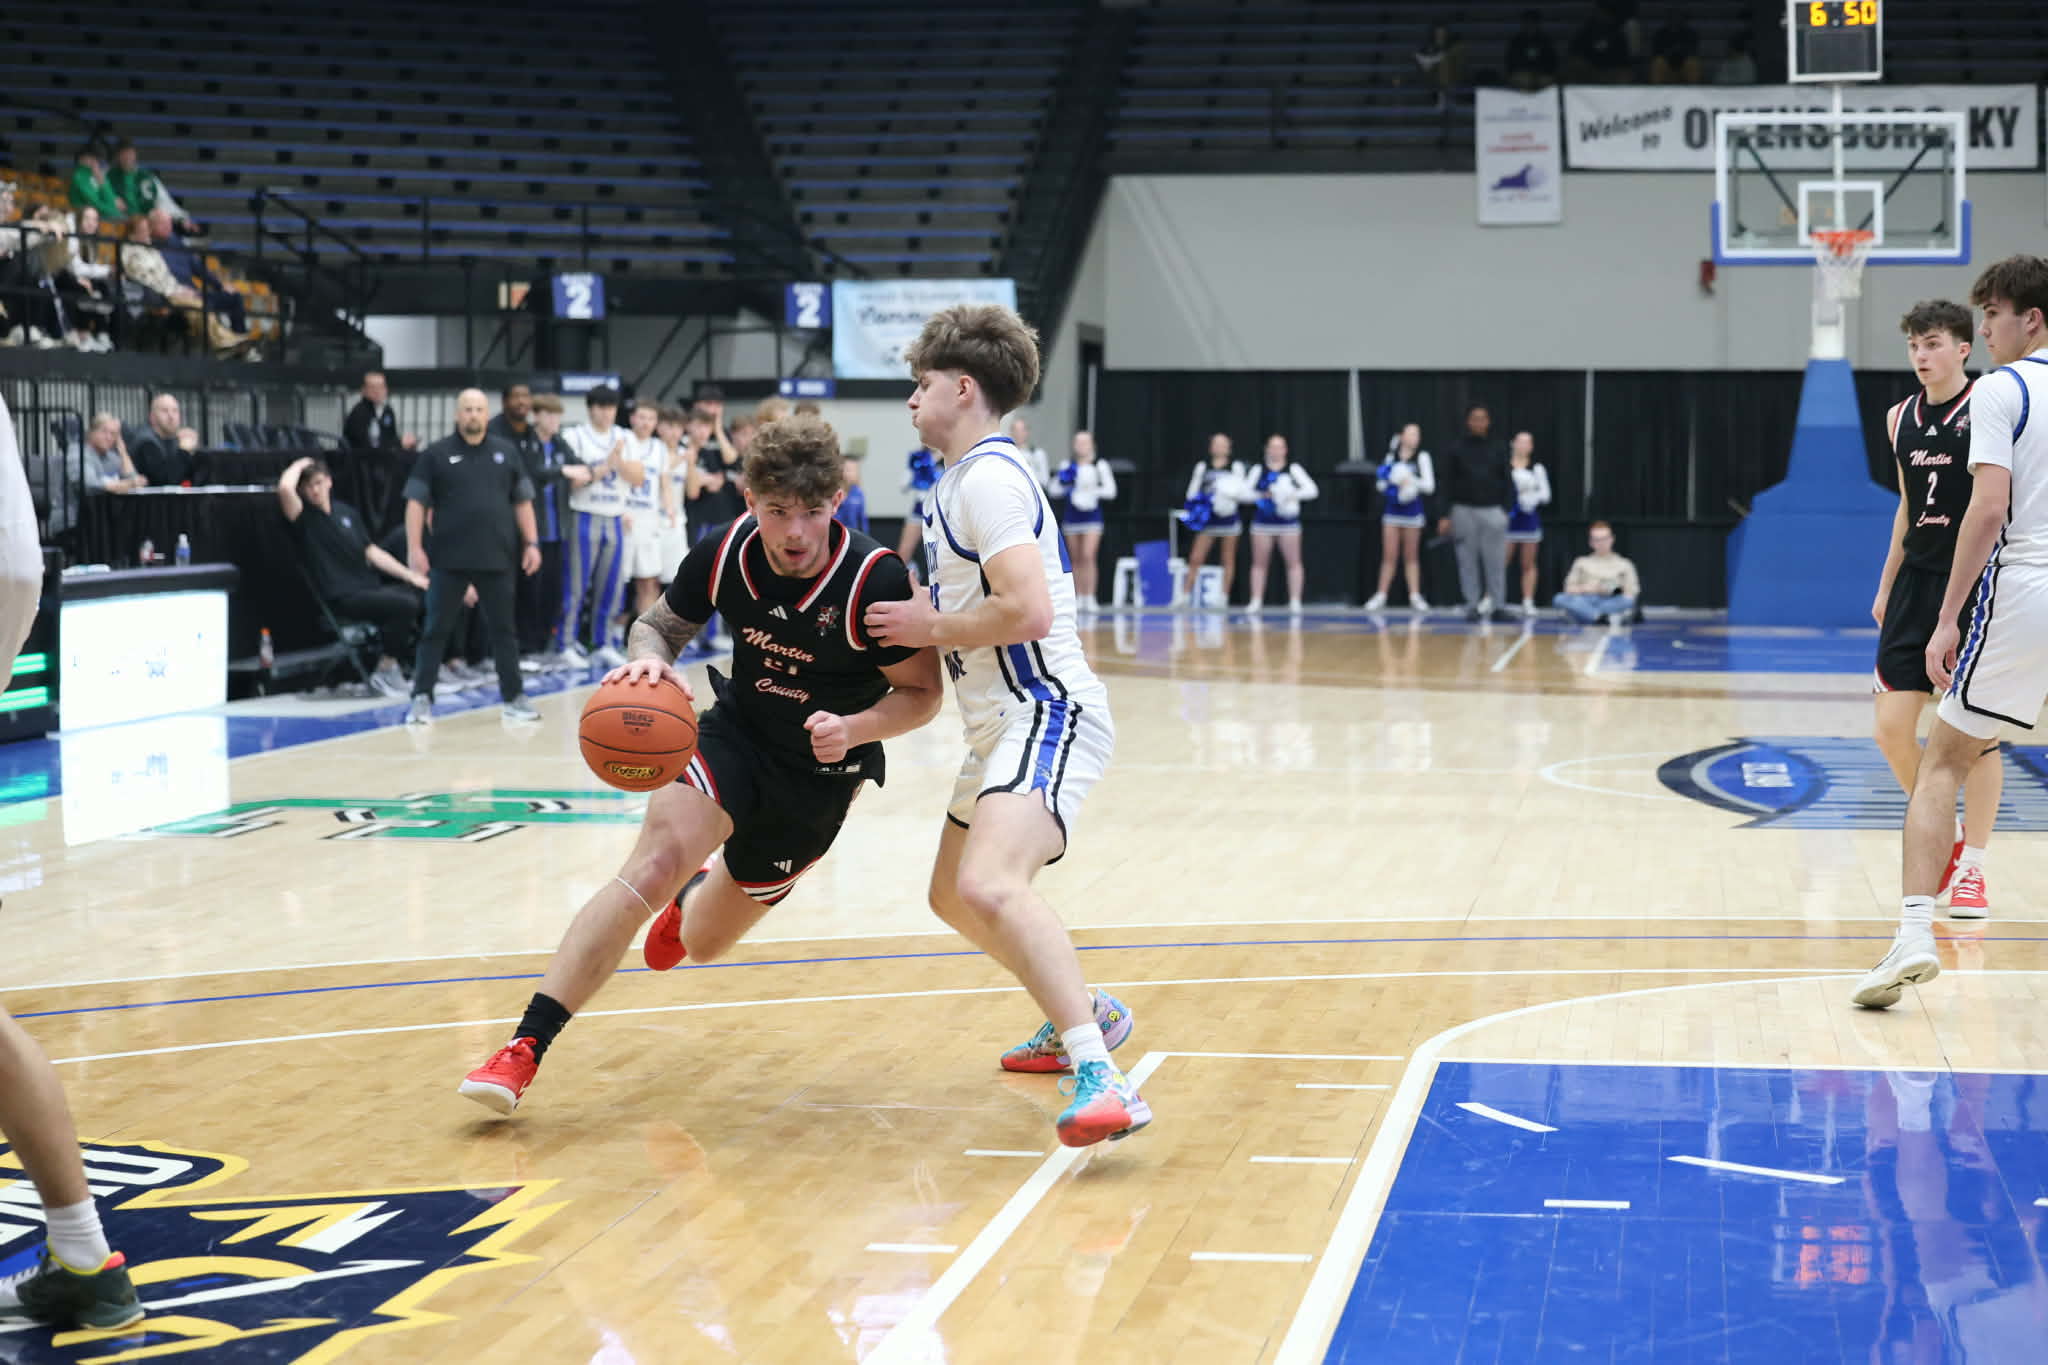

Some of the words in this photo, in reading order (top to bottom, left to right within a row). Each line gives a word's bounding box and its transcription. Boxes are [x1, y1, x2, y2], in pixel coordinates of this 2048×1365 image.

[1580, 106, 1673, 142] Welcome
[1968, 106, 2020, 149] KY
[1641, 133, 1661, 150] to
[565, 283, 593, 319] 2
[796, 295, 821, 328] 2
[1909, 450, 1953, 466] Martin
[1926, 471, 1939, 506] 2
[1915, 511, 1951, 528] County
[742, 626, 815, 663] Martin
[755, 678, 811, 704] County
